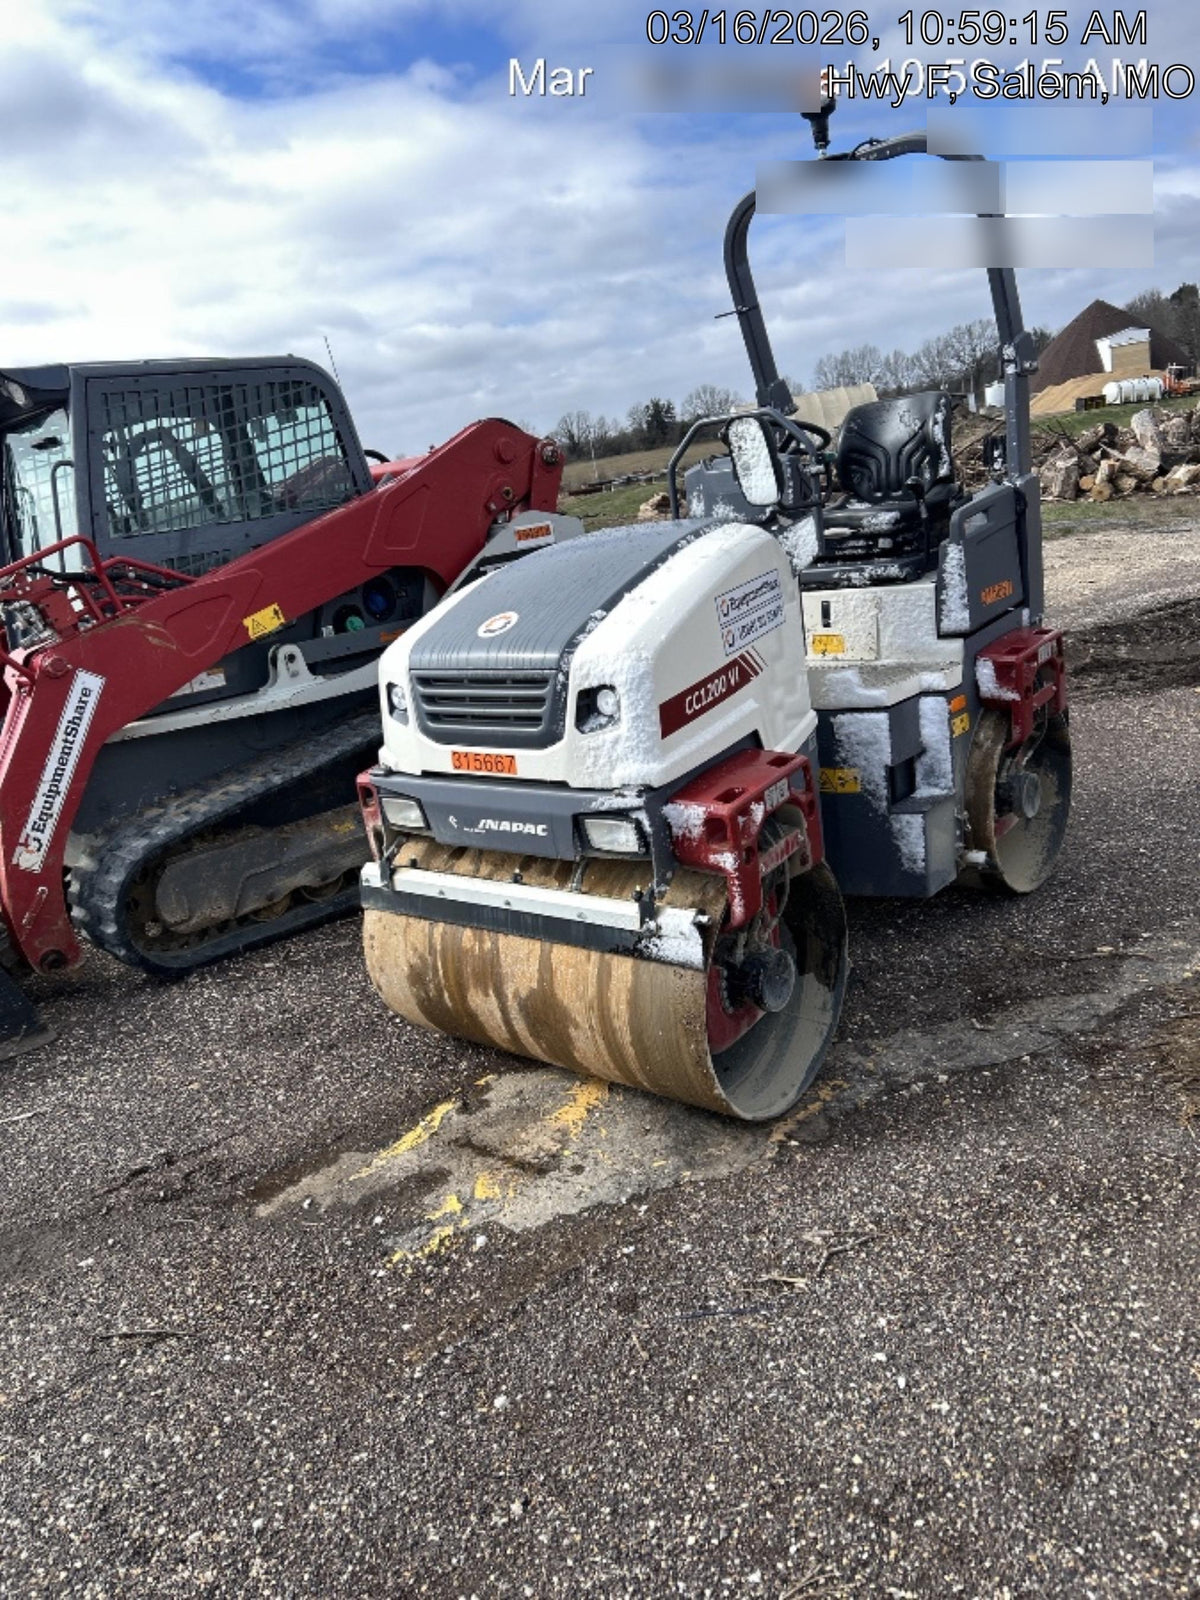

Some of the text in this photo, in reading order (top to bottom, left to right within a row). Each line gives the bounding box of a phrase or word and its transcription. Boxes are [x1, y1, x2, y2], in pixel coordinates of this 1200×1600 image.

[685, 674, 727, 715] CC1200
[31, 686, 93, 834] EquipmentShare
[452, 751, 516, 774] 315667
[477, 818, 548, 837] NAPAC
